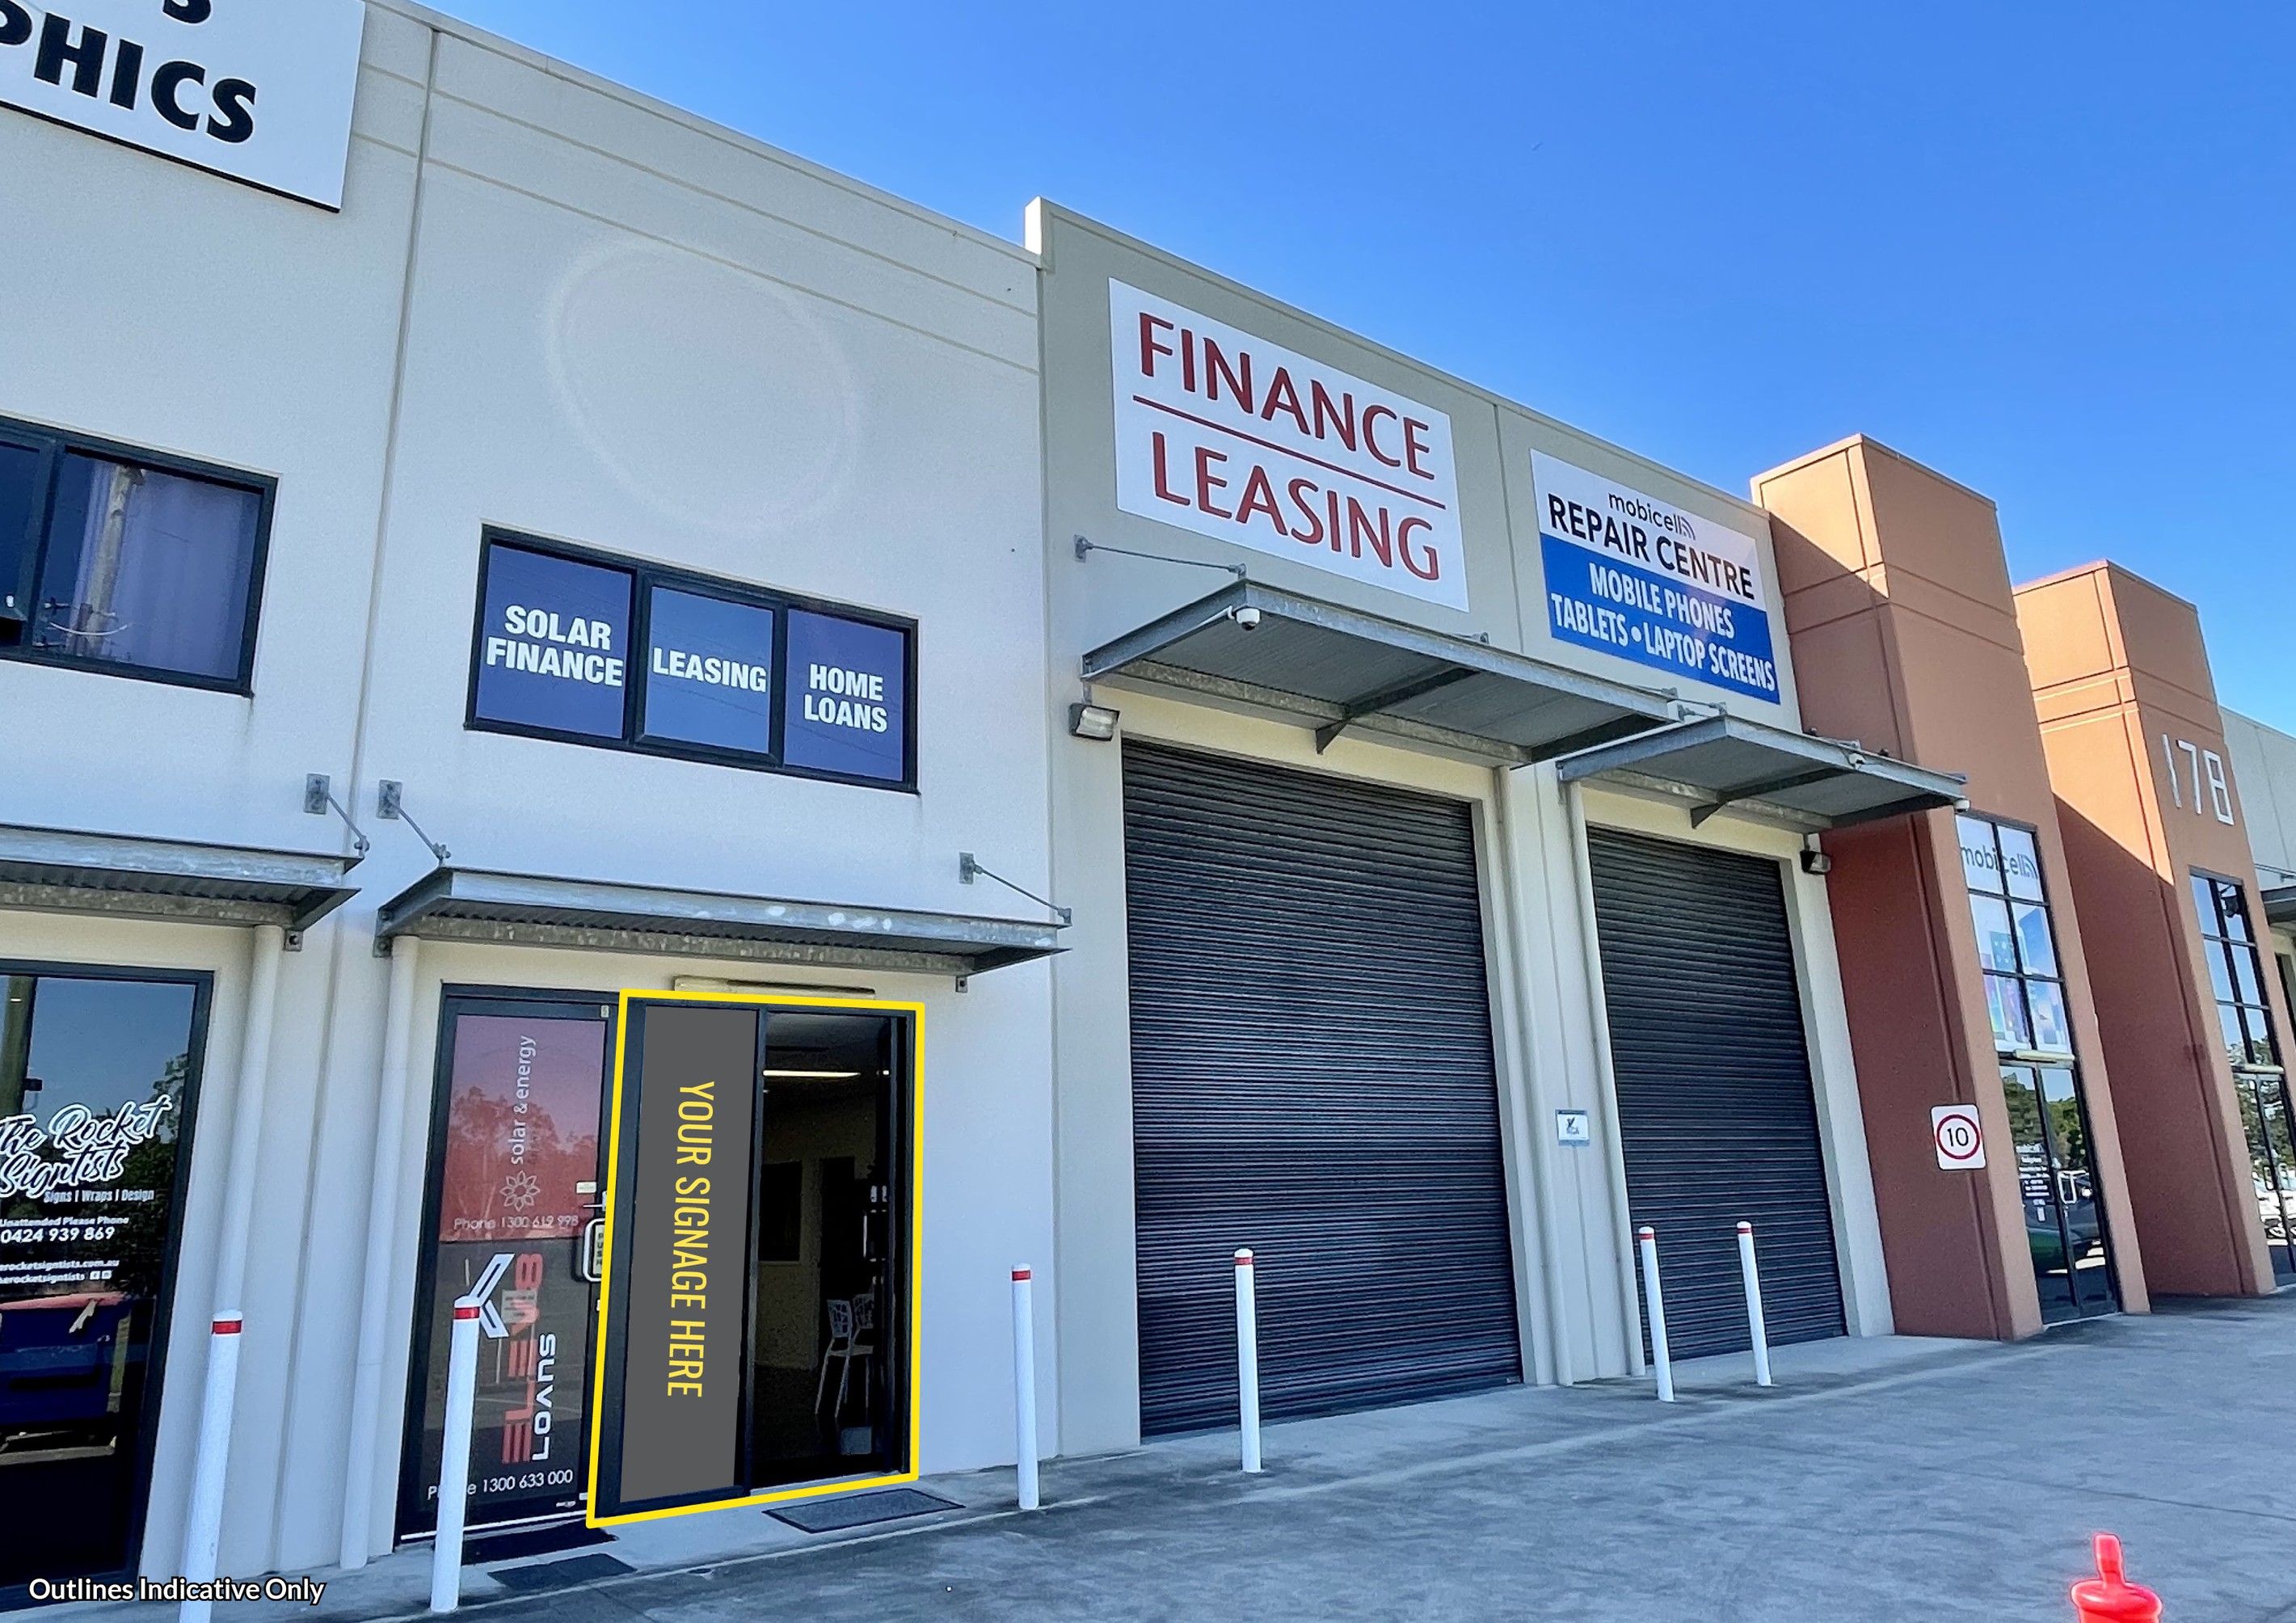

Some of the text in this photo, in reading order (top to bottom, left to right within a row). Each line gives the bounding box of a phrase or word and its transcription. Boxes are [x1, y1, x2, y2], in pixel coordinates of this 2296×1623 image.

[1139, 312, 1434, 480] FINANCE
[1152, 431, 1439, 580] LEASING
[1608, 492, 1683, 536] mobicell
[1548, 493, 1755, 601] REPAIR CENTRE
[1589, 562, 1734, 639] MOBILE PHONES
[504, 605, 611, 651] SOLAR
[1551, 592, 1776, 692] TABLETS LAPTOP SCREENS
[486, 636, 624, 687] FINANCE
[652, 647, 767, 693] LEASING
[809, 663, 884, 702] HOME
[803, 694, 888, 733] LOANS
[2161, 733, 2235, 826] 178
[0, 1094, 173, 1156] The Rocket
[508, 1035, 537, 1165] solar & energy
[1946, 1127, 1970, 1148] 10
[0, 1139, 129, 1199] Signtists
[44, 1189, 154, 1204] Signs Wraps Design
[453, 1217, 496, 1229] Phone
[501, 1216, 529, 1228] 1300
[557, 1215, 579, 1226] 998
[1, 1226, 116, 1243] 0424 939 869
[532, 1334, 557, 1461] LOANS
[482, 1476, 516, 1493] 1300
[519, 1473, 545, 1489] 633
[547, 1469, 574, 1485] 000
